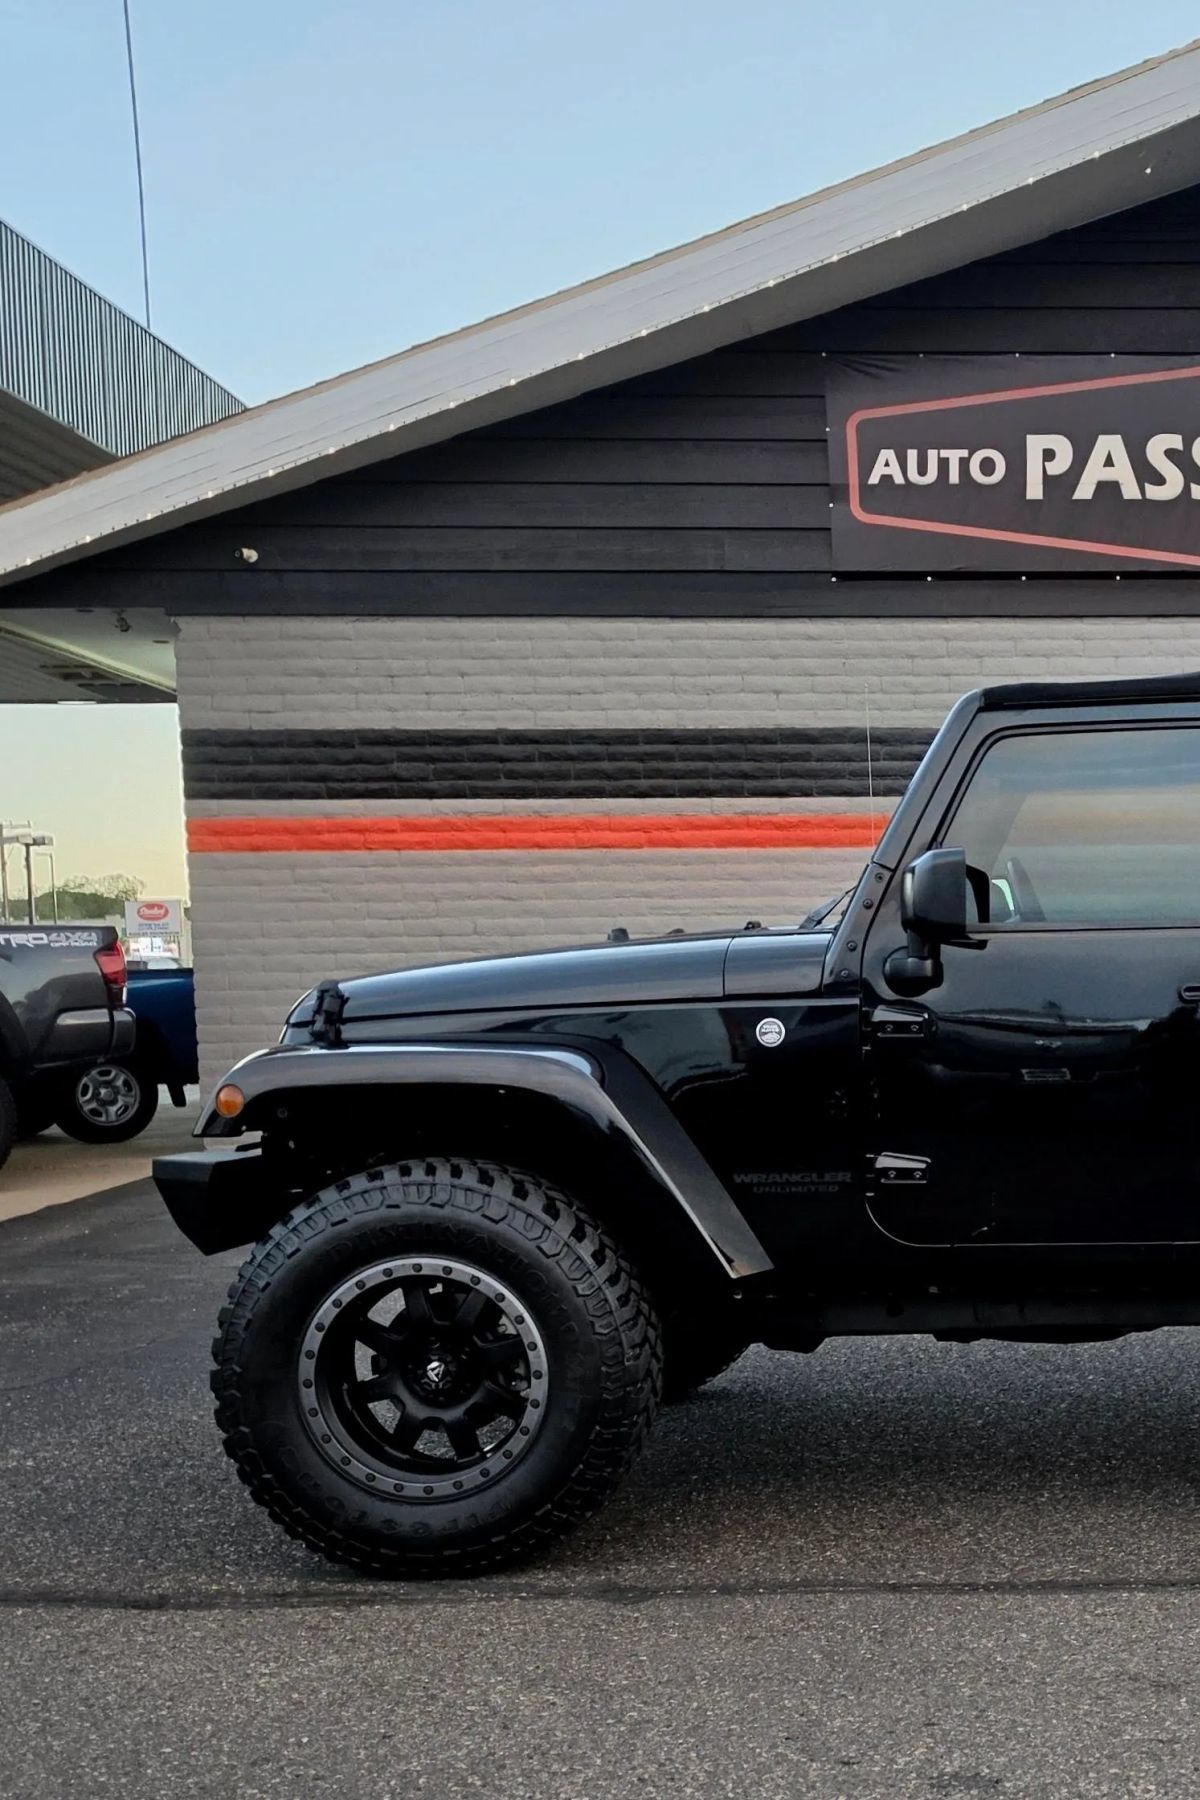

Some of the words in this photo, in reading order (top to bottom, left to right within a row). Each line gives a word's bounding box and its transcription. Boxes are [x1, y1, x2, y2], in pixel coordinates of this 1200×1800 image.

[868, 449, 1006, 485] AUTO
[732, 1172, 852, 1183] WRANGLER
[752, 1184, 840, 1193] UNLIMITED
